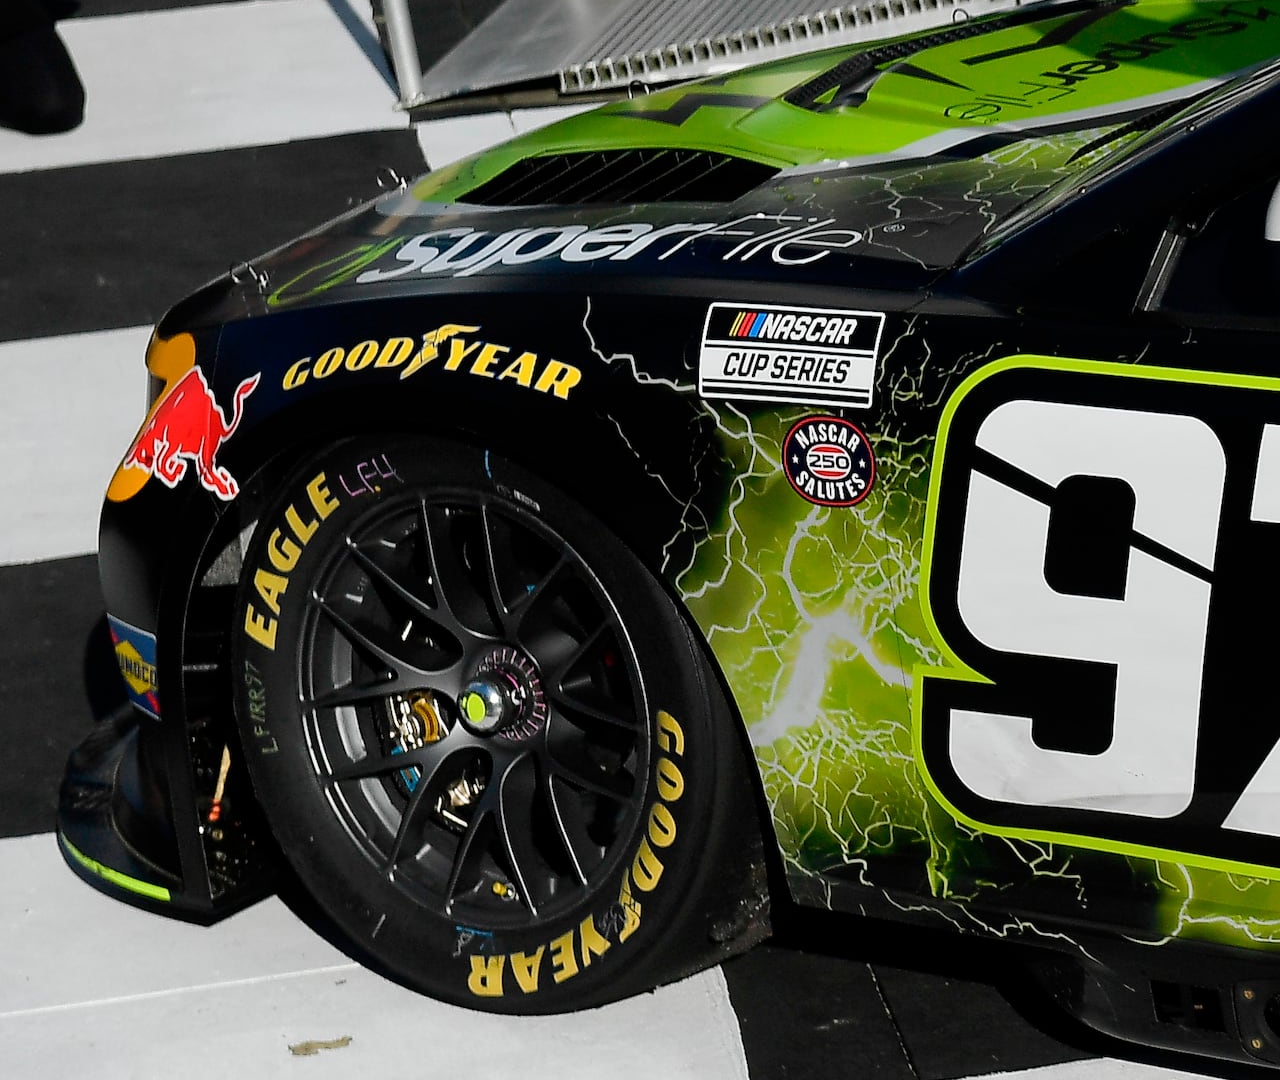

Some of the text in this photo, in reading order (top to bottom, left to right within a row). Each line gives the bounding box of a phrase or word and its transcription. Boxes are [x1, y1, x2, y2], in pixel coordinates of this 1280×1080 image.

[758, 312, 858, 345] NASCAR
[282, 328, 583, 400] GOODYEAR
[723, 352, 851, 384] CUP SERIES
[794, 422, 861, 453] NASCAR
[808, 454, 850, 469] 250
[795, 470, 866, 500] SALUTES
[244, 471, 341, 651] EAGLE
[467, 709, 685, 997] GOODYEAR
